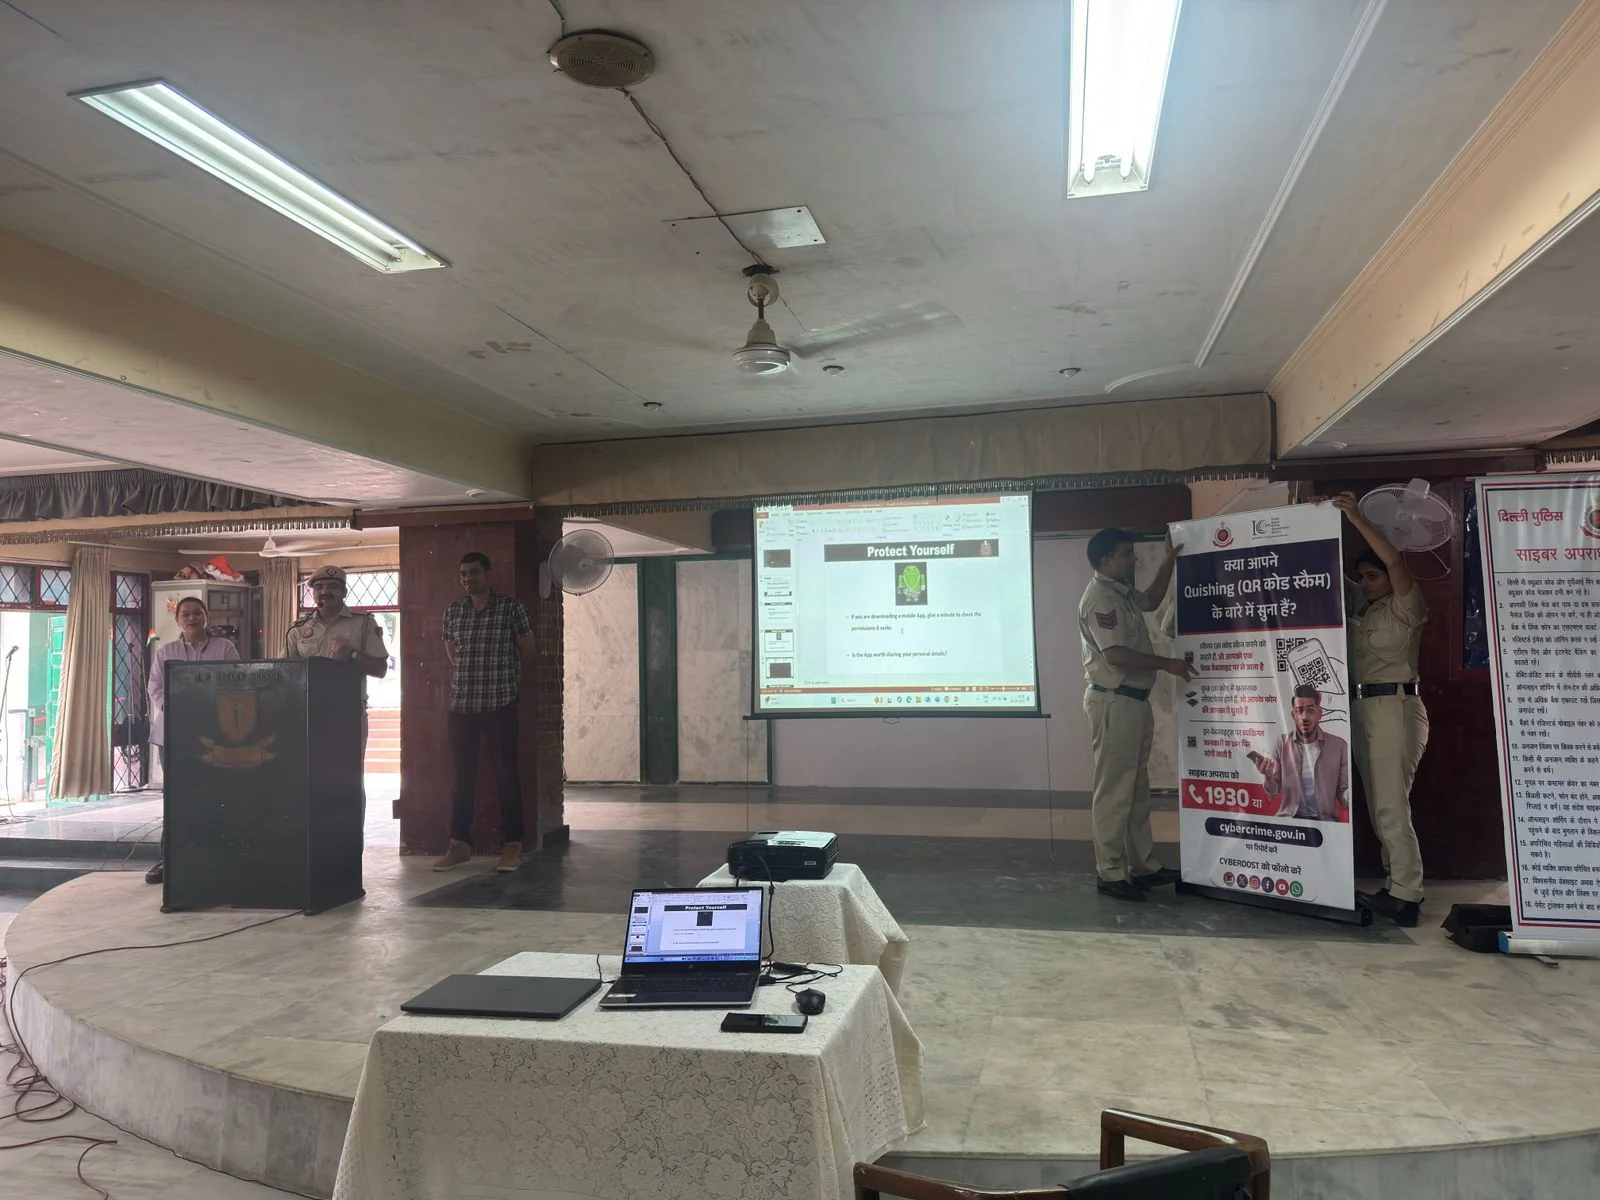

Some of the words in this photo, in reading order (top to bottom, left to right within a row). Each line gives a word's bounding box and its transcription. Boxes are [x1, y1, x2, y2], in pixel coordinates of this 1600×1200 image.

[1498, 509, 1528, 522] दिल्ली
[1532, 508, 1563, 526] पुलिस
[867, 546, 907, 558] Protect
[909, 544, 955, 556] Yourself
[1516, 549, 1557, 563] साइबर
[1224, 560, 1244, 572] क्या
[1248, 552, 1278, 569] आपने
[1185, 583, 1234, 598] Quishing
[1238, 579, 1261, 595] (QR
[1264, 573, 1289, 591] कोड
[1293, 569, 1331, 590] स्कैम)
[1212, 605, 1222, 620] के
[1225, 603, 1242, 618] बारे
[1257, 604, 1277, 621] सुना
[1188, 770, 1208, 778] साइबर
[1209, 770, 1229, 779] अपराध
[1206, 787, 1249, 807] 1930
[1252, 799, 1263, 808] या
[1220, 823, 1306, 841] cybercrime.gov.in
[1254, 843, 1268, 852] रिपोर्ट
[1219, 858, 1260, 870] CYBERDOST
[1261, 862, 1269, 870] को
[1272, 863, 1289, 874] फॉलो
[1291, 866, 1301, 875] करें
